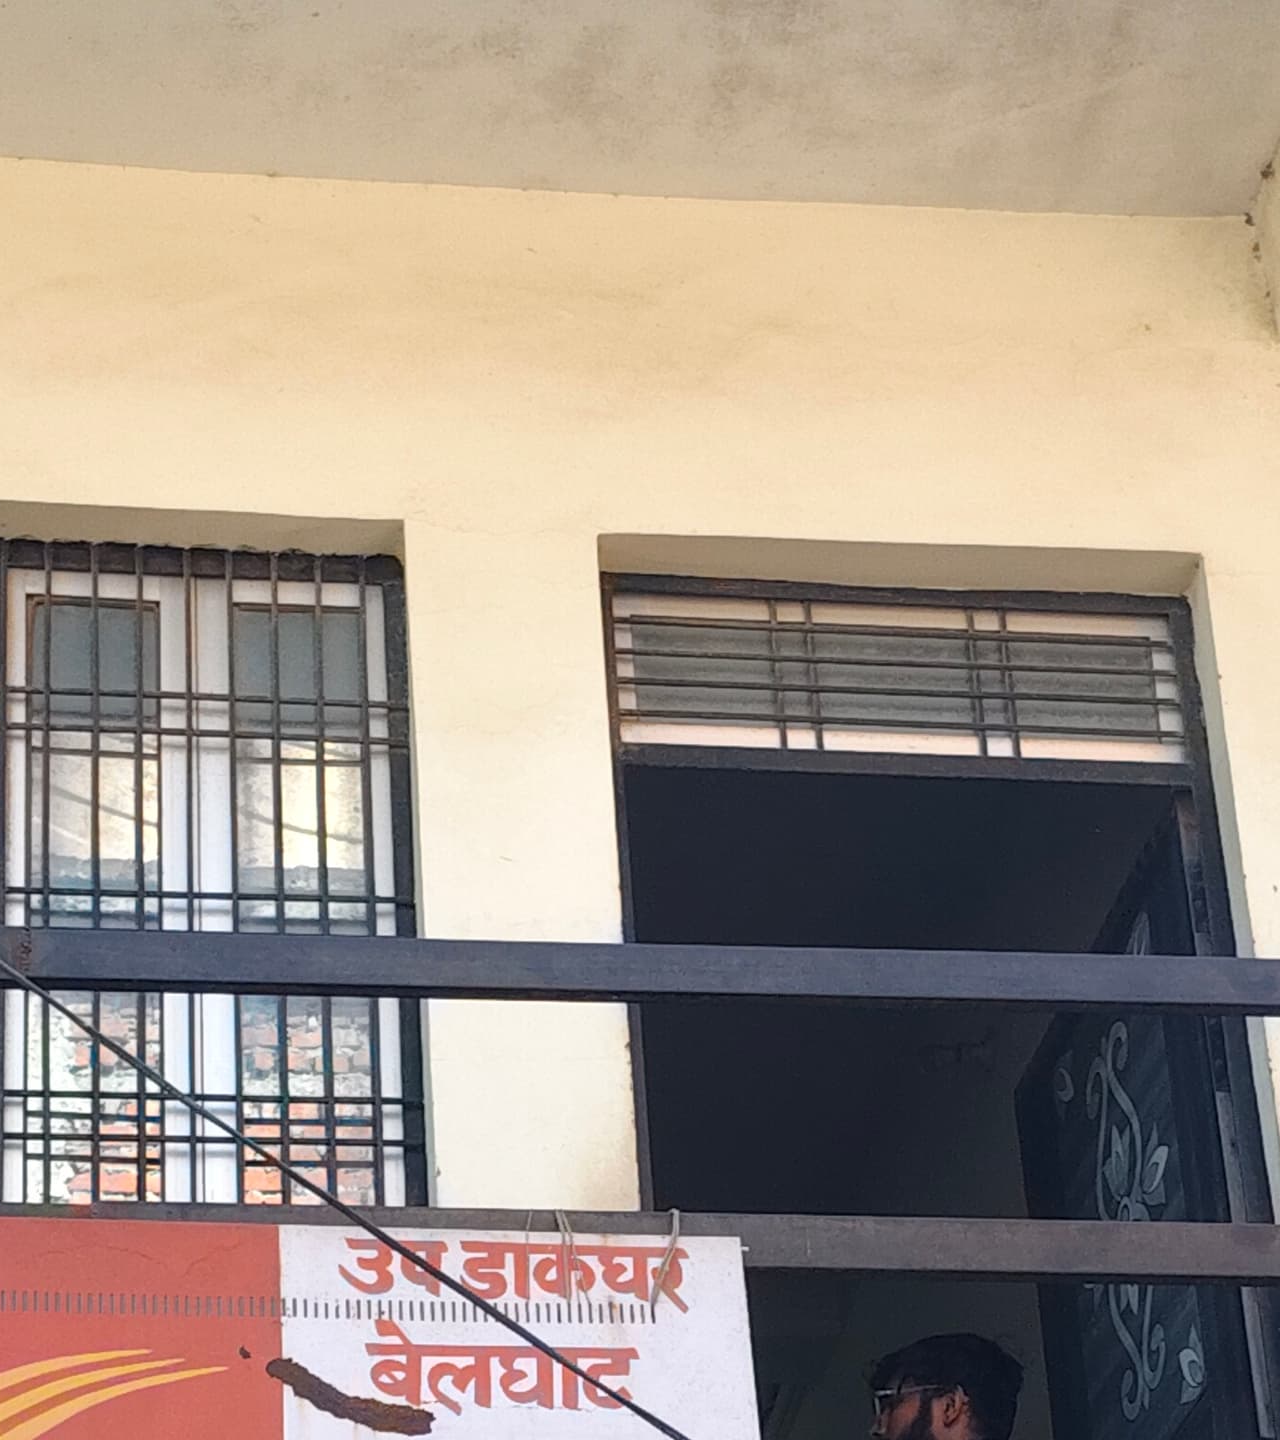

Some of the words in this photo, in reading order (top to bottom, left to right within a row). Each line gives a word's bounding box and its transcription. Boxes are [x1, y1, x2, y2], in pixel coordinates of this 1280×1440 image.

[338, 1237, 449, 1298] उप
[459, 1239, 690, 1313] डाकघर
[365, 1319, 640, 1416] बेलघाट
